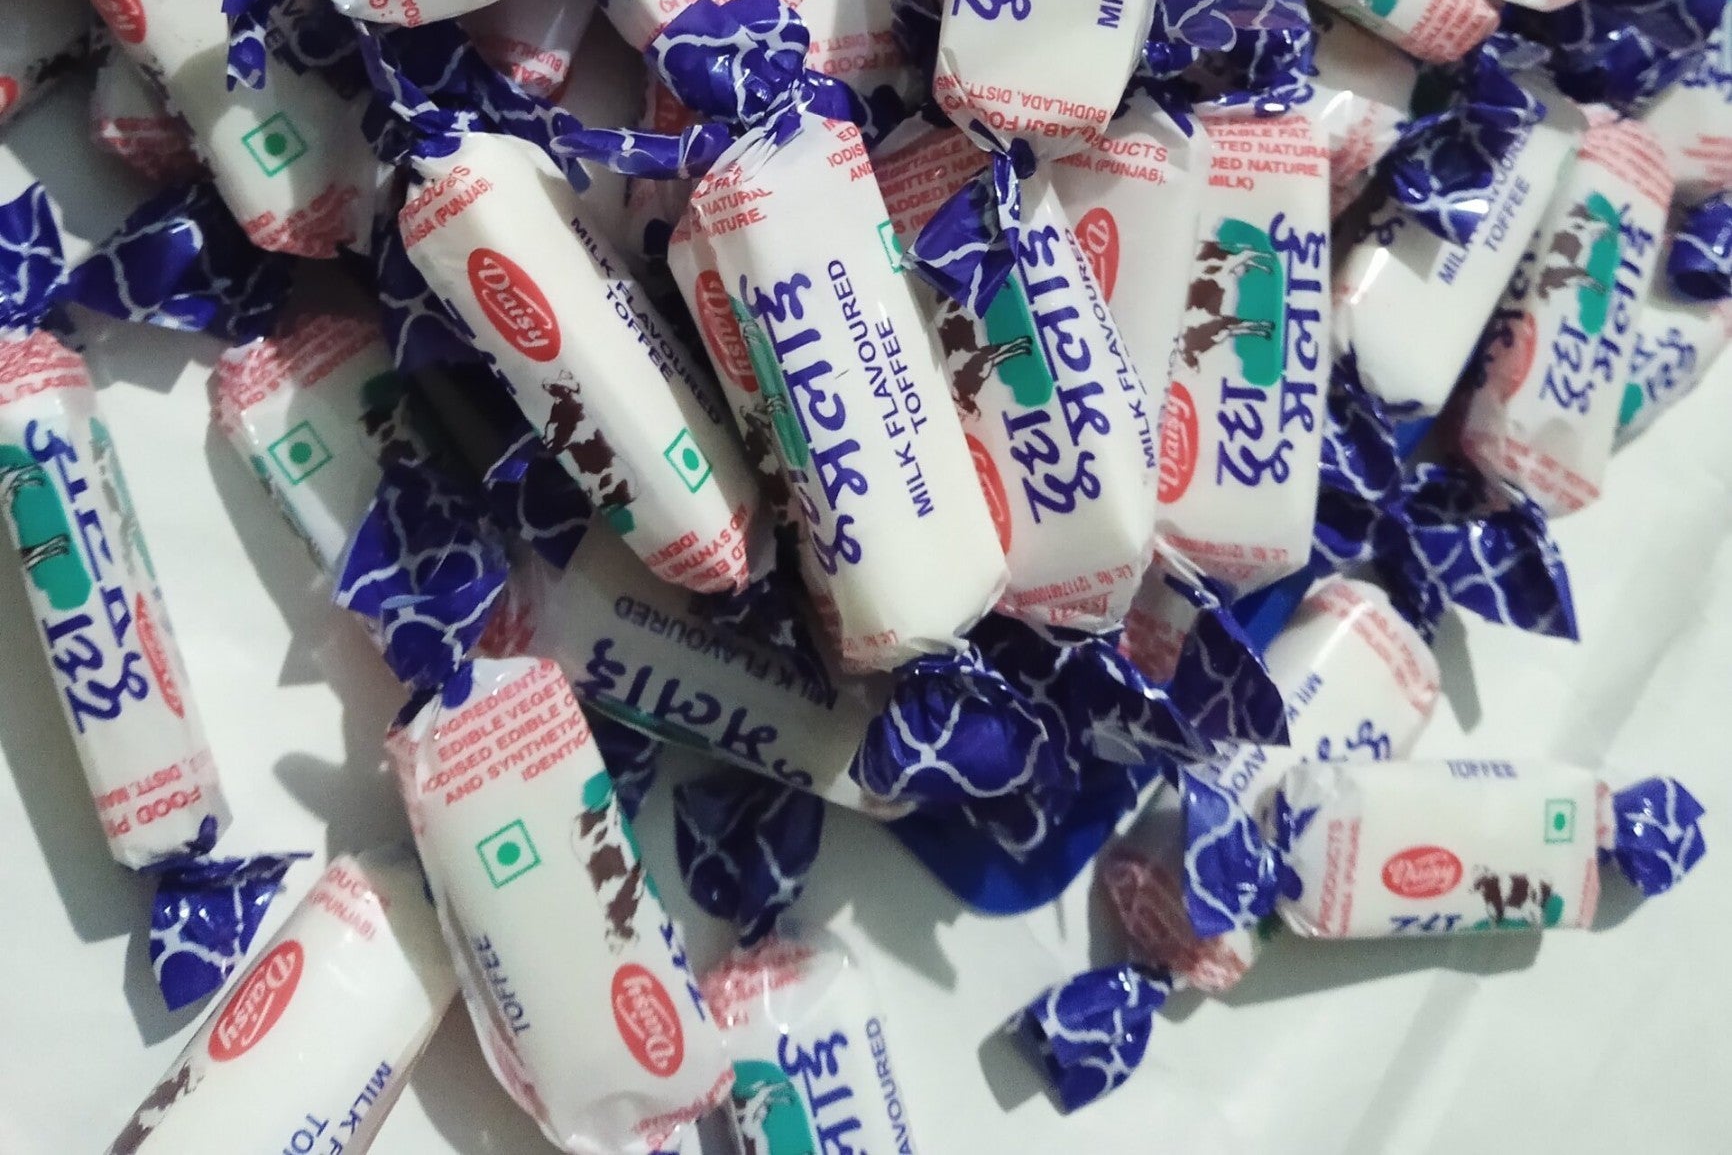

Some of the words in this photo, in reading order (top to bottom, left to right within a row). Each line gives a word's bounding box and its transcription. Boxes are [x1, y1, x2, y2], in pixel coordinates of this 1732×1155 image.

[571, 217, 616, 278] MILK
[701, 187, 773, 217] NATURAL
[1484, 177, 1532, 252] TOFFEE
[477, 256, 553, 352] Daisy
[606, 283, 674, 383] TOFFEE
[827, 257, 910, 439] FLAVOURED
[1064, 226, 1139, 394] FLAVOURED
[1269, 210, 1326, 434] मलाई
[739, 271, 869, 511] मलाई
[873, 315, 929, 436] TOFFEE
[893, 446, 935, 520] MILK
[1002, 409, 1102, 526] दूध
[1125, 398, 1156, 470] MILK
[1215, 377, 1294, 488] दूध
[44, 613, 149, 734] दूध
[1447, 760, 1517, 779] TOFFEE
[216, 948, 297, 1051] Daisy
[476, 933, 532, 1036] TOFFEE
[339, 1059, 394, 1135] MILK
